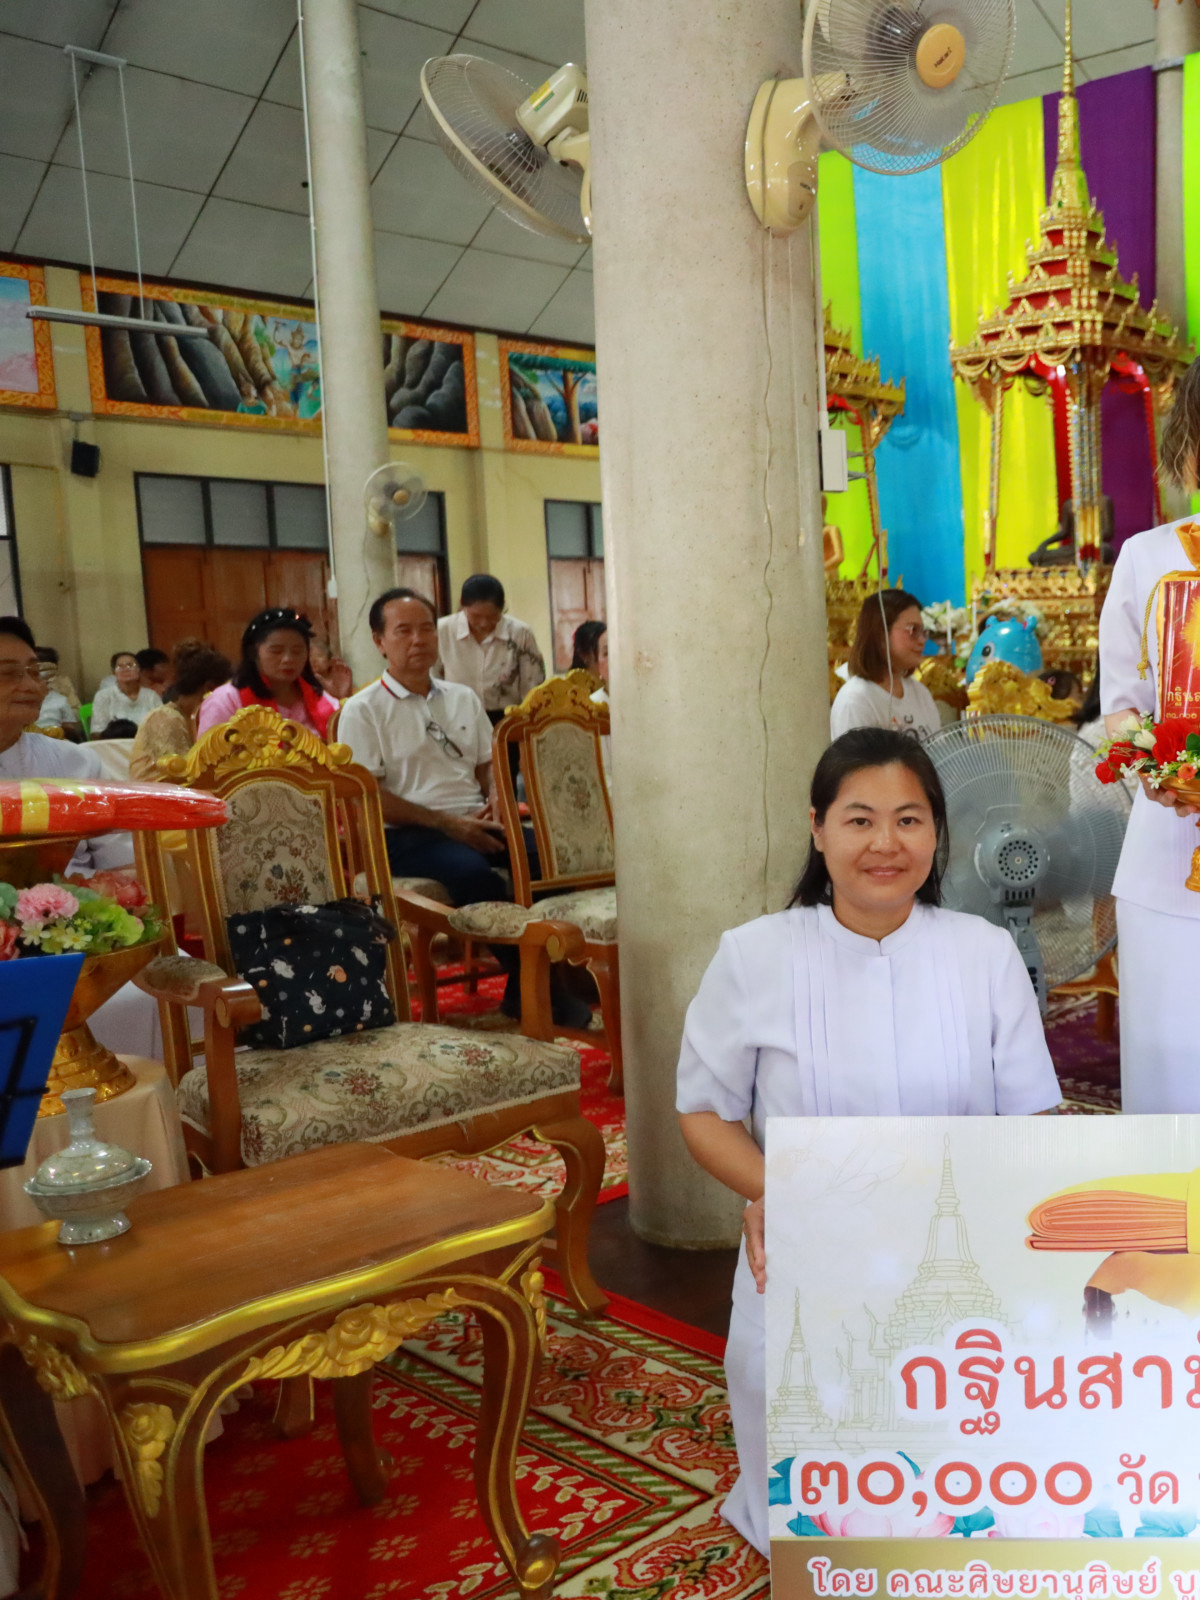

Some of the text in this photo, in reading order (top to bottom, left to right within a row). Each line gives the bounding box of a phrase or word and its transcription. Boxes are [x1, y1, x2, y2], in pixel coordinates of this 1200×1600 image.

[801, 1461, 1092, 1517] ๓๐,๐๐๐
[1117, 1453, 1179, 1504] วัด
[812, 1561, 873, 1593] โดย
[890, 1561, 1157, 1600] คณะศิษยานุศิษย์
